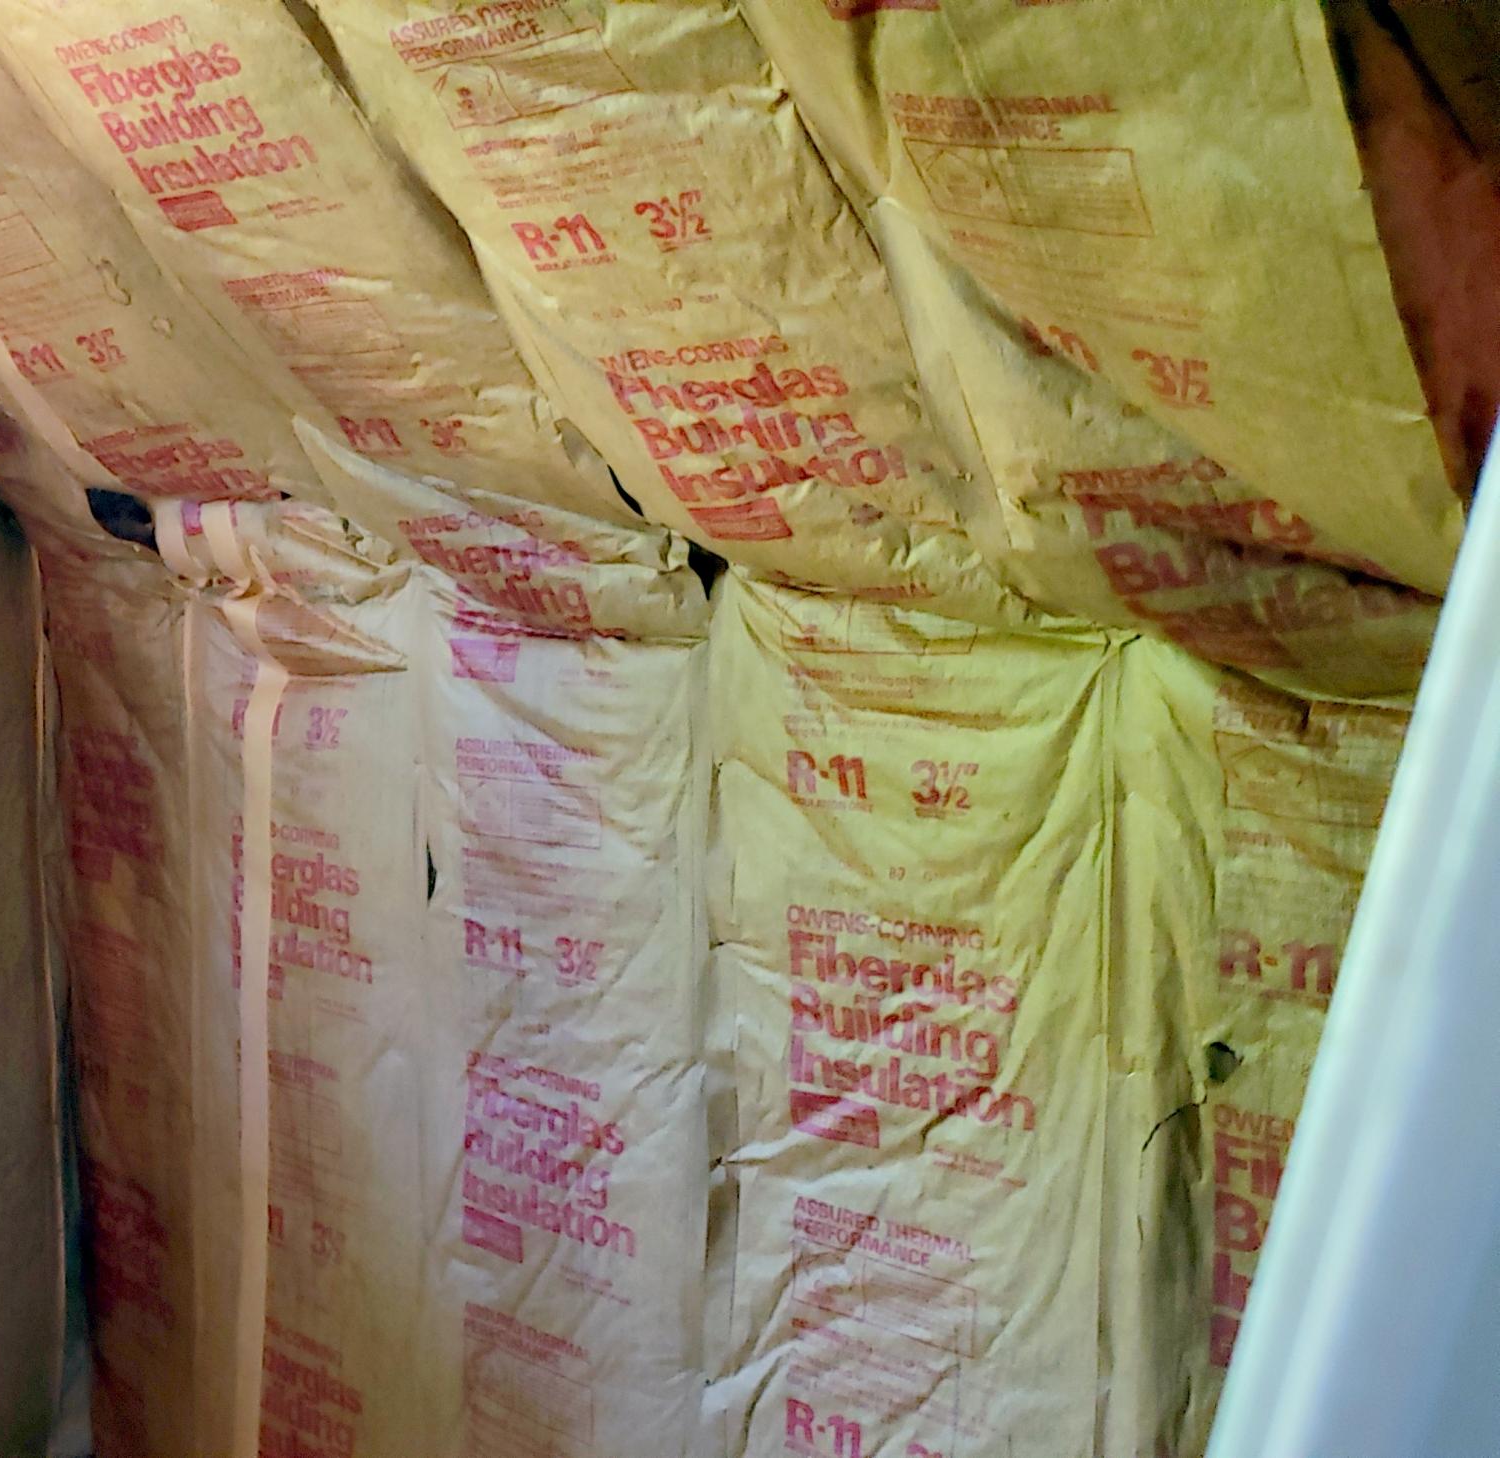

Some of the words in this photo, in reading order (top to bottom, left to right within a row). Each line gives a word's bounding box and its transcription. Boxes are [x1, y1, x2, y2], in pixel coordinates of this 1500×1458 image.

[389, 12, 476, 49] ASSURED
[398, 18, 545, 65] PERFORMANCE
[69, 42, 242, 108] Fiberglas
[99, 95, 265, 155] Building
[126, 134, 320, 195] Insulation
[510, 213, 607, 261] R-11
[786, 750, 868, 800] R-11
[464, 919, 523, 962] R-11
[786, 904, 986, 951] OWENS-CORNING
[788, 929, 1019, 1014] Fiberglas
[1219, 928, 1335, 994] R-11
[789, 980, 1000, 1081] Building
[467, 1071, 624, 1155] Fiberglas
[788, 1034, 1036, 1131] Insulation
[462, 1168, 636, 1258] Insulation
[792, 1216, 932, 1269] PERFORMANCE
[793, 1196, 880, 1232] ASSURED
[885, 1219, 976, 1265] THERMAL
[785, 1397, 862, 1458] R-11
